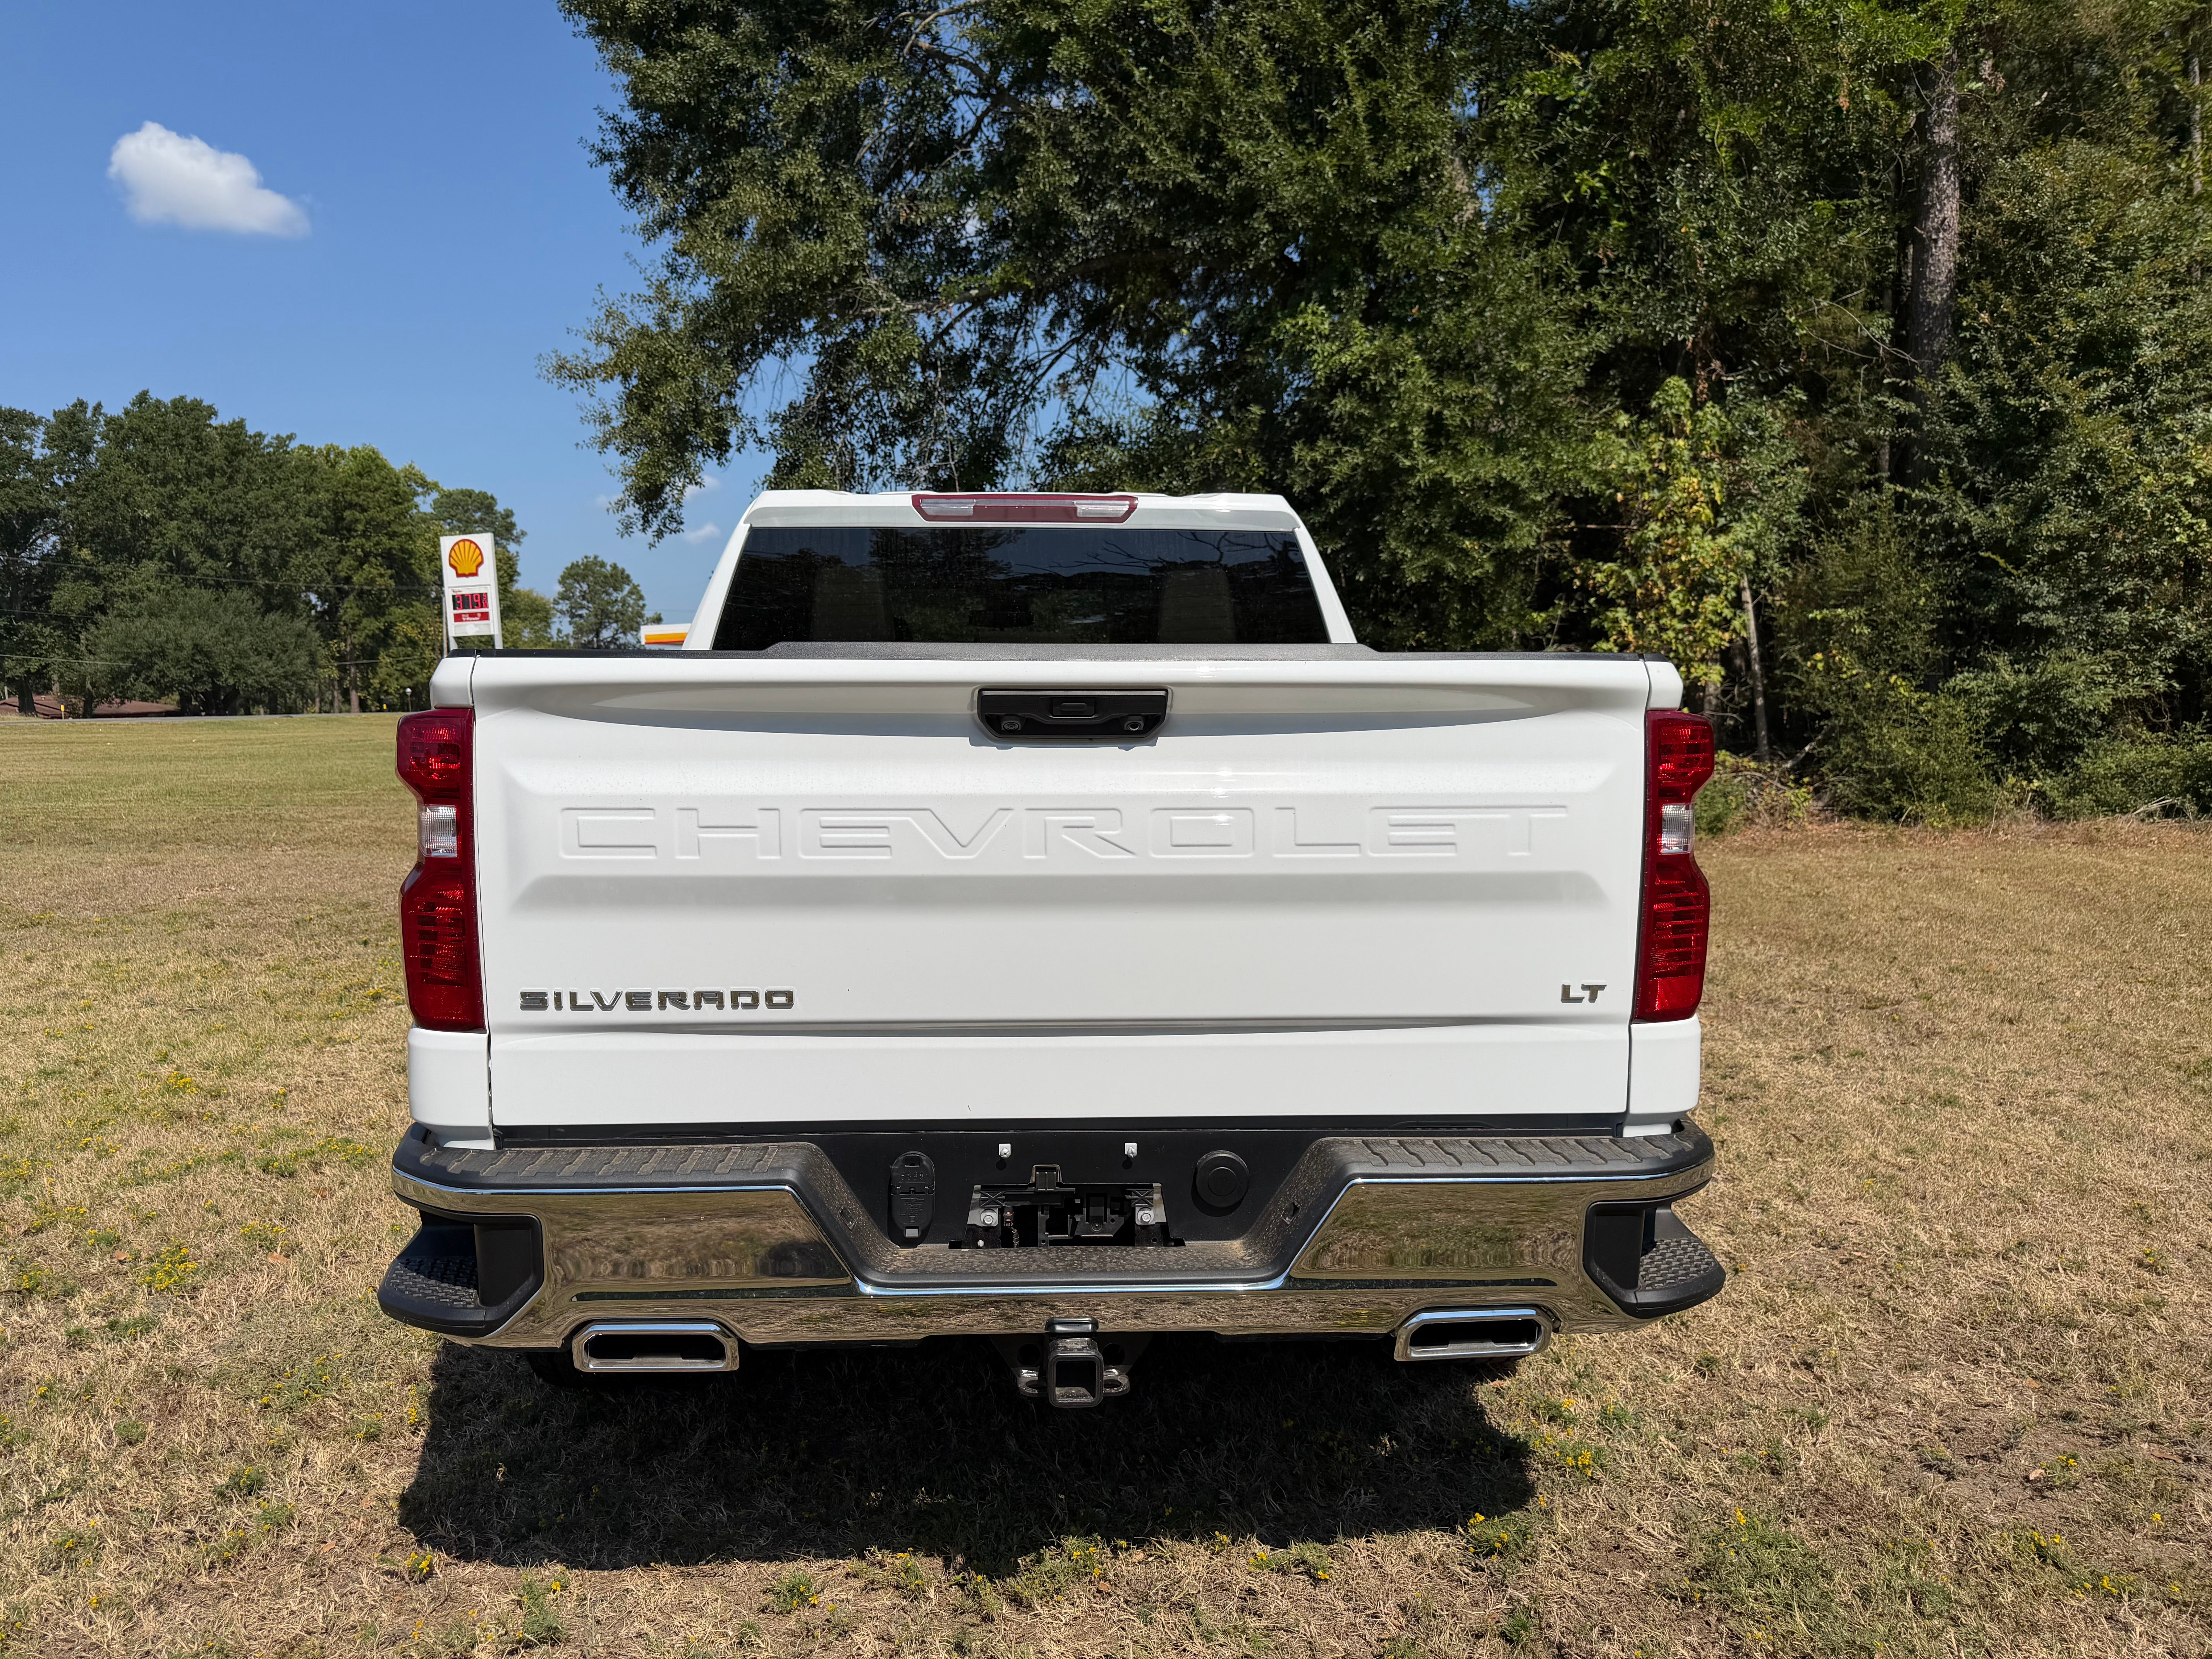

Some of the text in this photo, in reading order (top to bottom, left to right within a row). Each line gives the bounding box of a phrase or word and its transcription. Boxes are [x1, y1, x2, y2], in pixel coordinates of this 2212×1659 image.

[560, 805, 1568, 859] CHEVROLET
[519, 989, 795, 1011] SILVERADO
[1561, 984, 1607, 1003] LT
